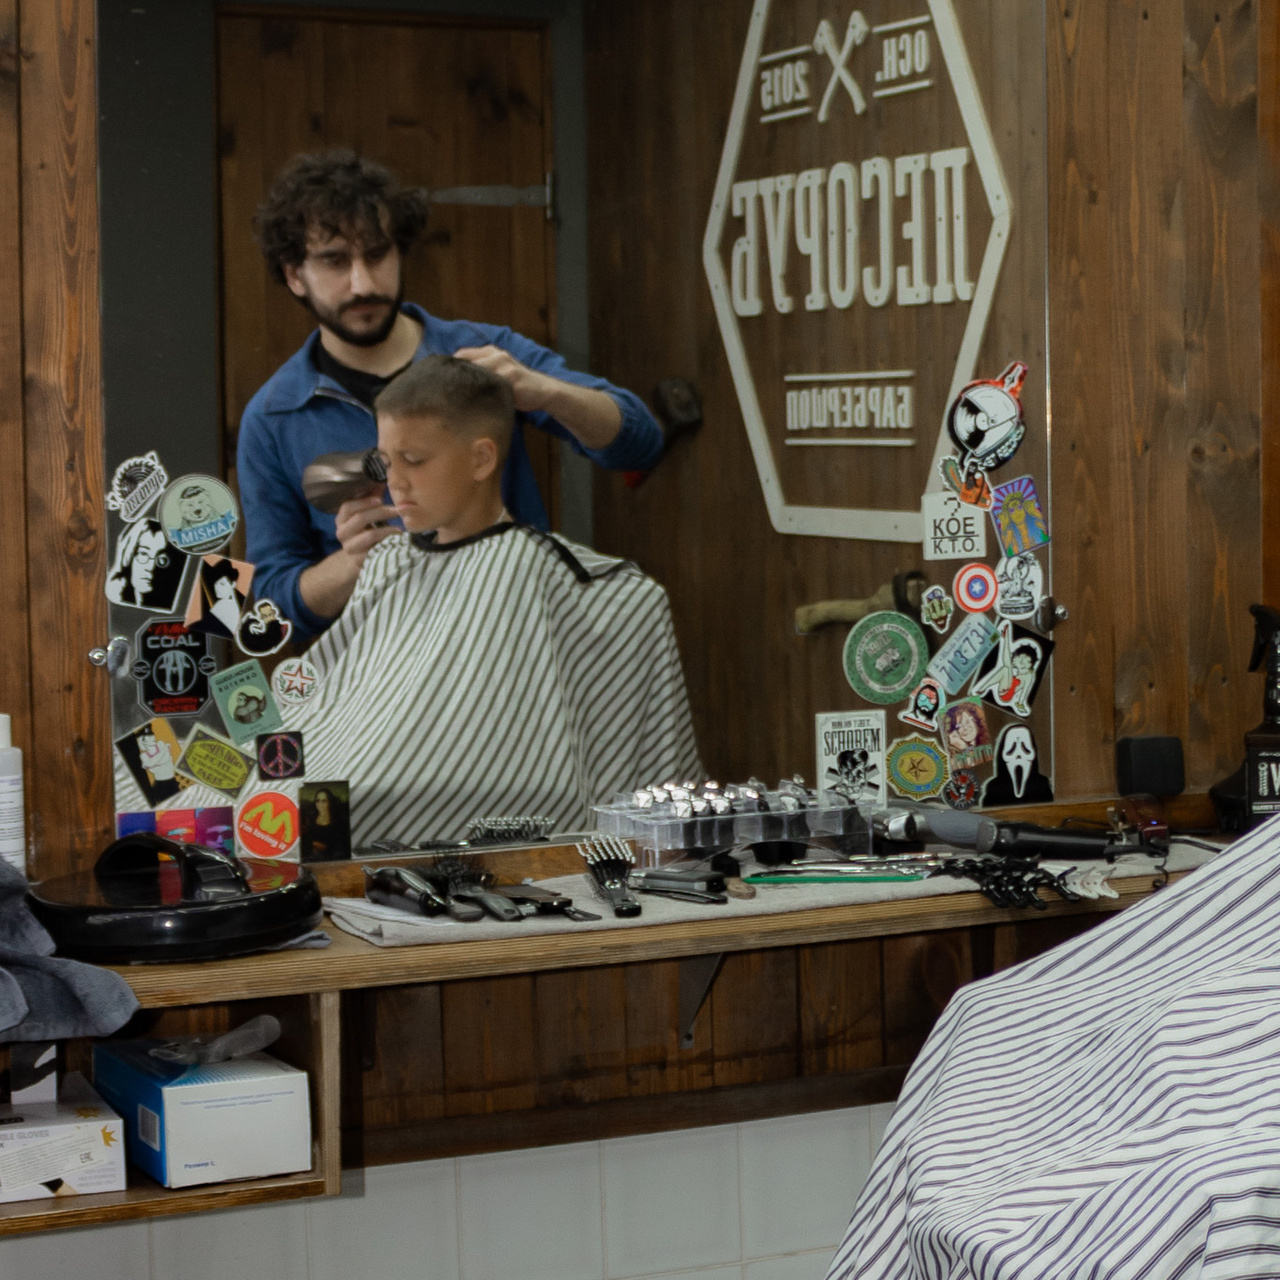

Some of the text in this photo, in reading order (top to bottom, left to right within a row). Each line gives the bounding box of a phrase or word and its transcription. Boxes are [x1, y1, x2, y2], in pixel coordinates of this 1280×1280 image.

[181, 521, 227, 543] MISHA
[932, 517, 976, 536] КОЕ
[146, 634, 200, 649] COAL
[939, 622, 991, 682] 713-731
[823, 728, 881, 756] SCHOREM
